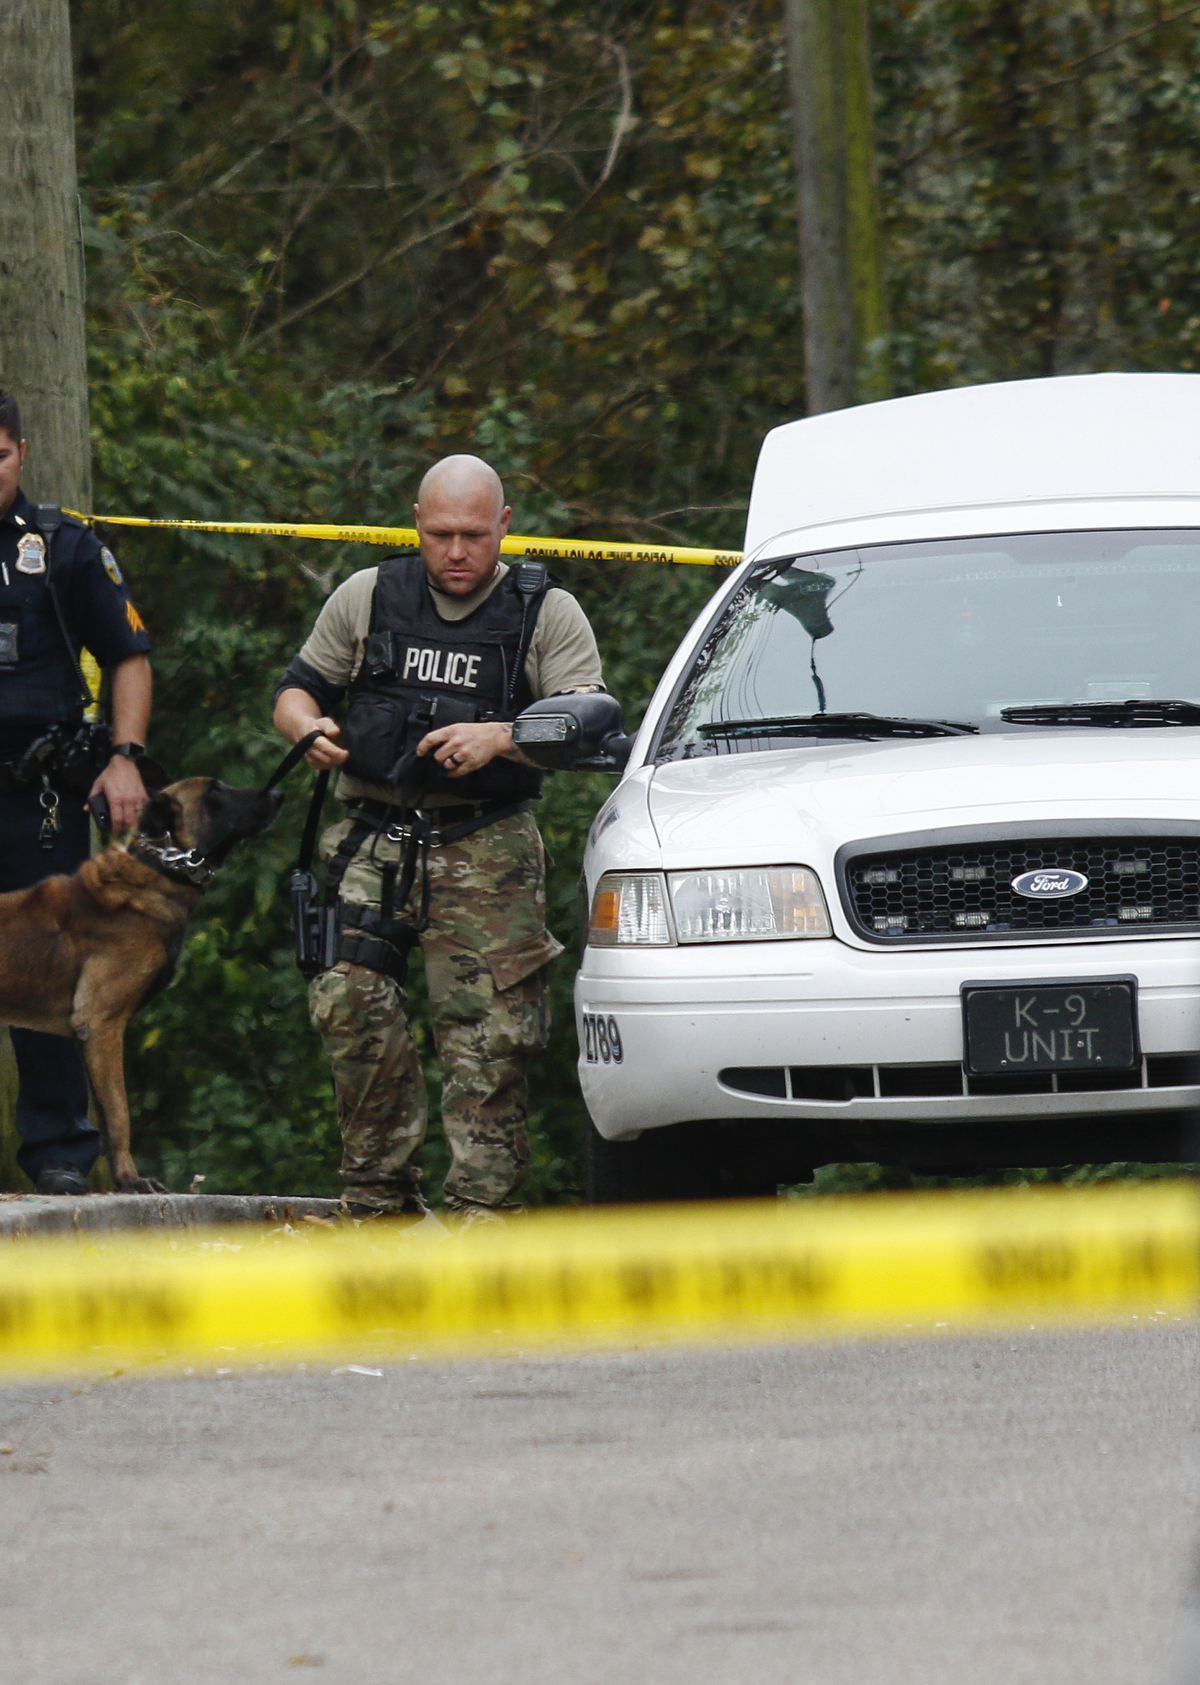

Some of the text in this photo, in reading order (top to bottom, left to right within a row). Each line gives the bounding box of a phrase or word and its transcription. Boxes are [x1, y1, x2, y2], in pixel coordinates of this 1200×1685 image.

[403, 647, 482, 688] POLICE
[1029, 874, 1070, 892] Ford
[1014, 994, 1087, 1028] K-9
[583, 1013, 624, 1064] 2789
[1004, 1028, 1099, 1063] UNIT
